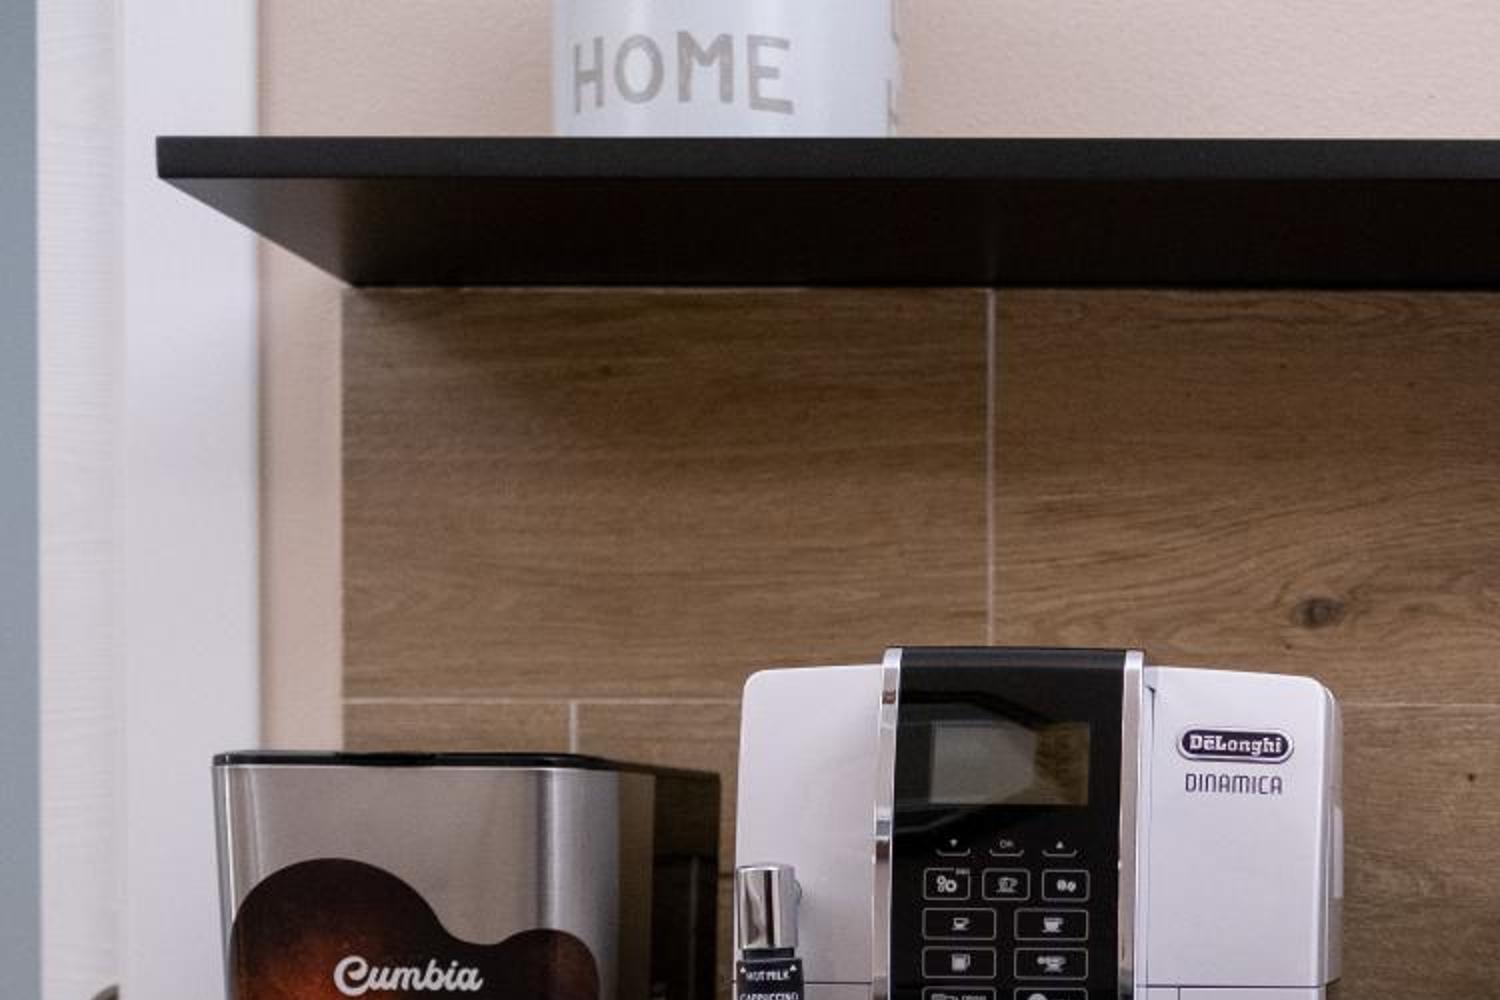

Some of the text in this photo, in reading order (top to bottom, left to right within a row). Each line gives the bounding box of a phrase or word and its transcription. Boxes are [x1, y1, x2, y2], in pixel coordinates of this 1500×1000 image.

[573, 31, 794, 115] HOME
[1185, 773, 1282, 794] DINAMICA
[333, 955, 483, 997] Cumbia
